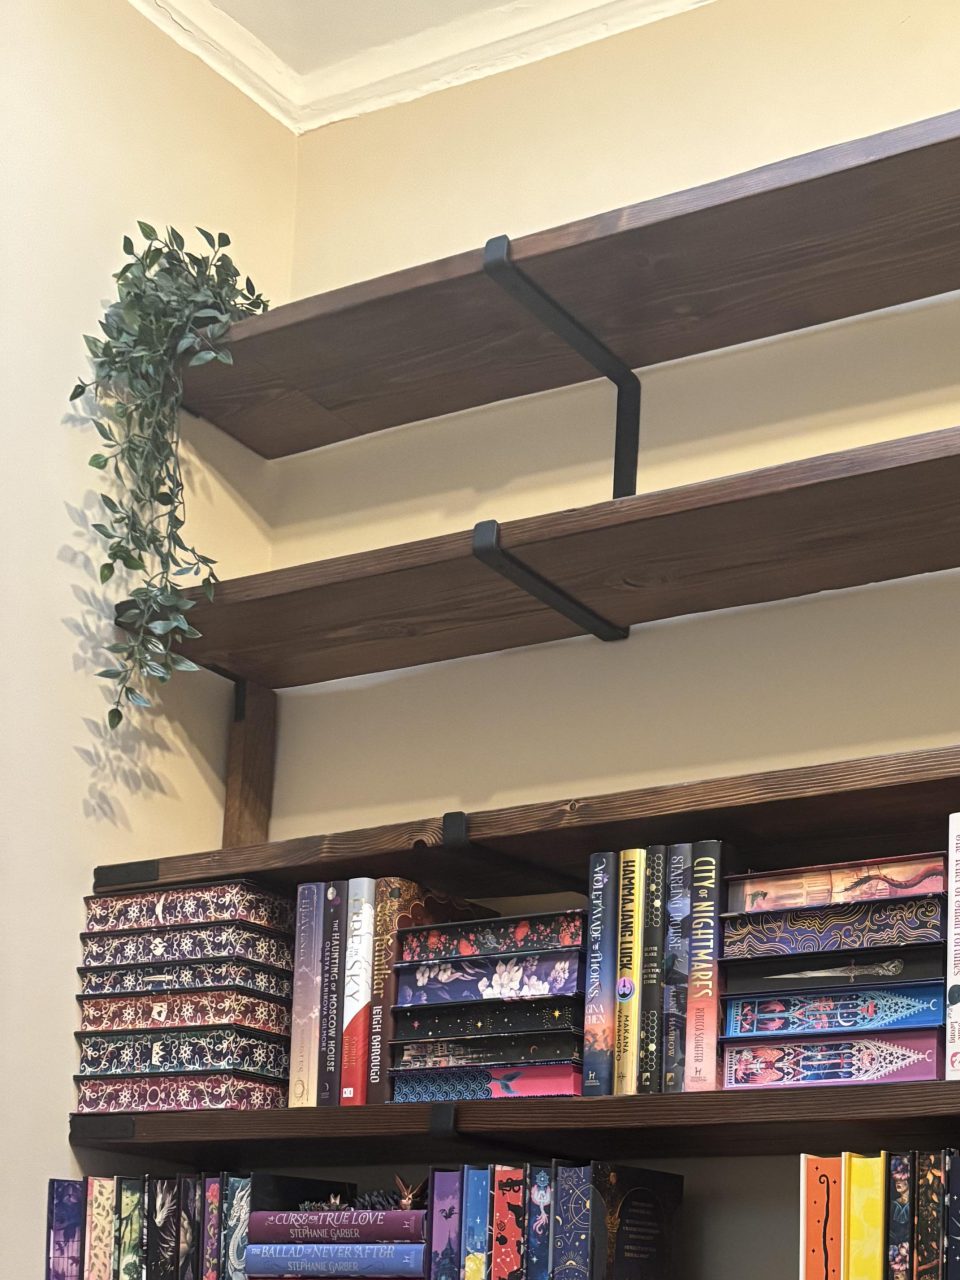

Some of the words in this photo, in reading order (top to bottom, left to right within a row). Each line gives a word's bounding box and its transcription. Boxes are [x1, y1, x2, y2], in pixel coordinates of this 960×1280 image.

[670, 855, 683, 907] STARLING
[693, 857, 715, 888] CITY
[620, 860, 635, 938] HAMMAJANG
[669, 914, 682, 950] HOUSE
[330, 933, 339, 980] HAUNTING
[620, 941, 633, 971] LUCK
[691, 902, 715, 999] NIGHTMARES
[328, 994, 337, 1037] MOSCOW
[372, 1006, 383, 1032] LEIGH
[327, 1041, 336, 1072] HOUSE
[290, 1227, 329, 1238] STEPHANIE
[330, 1229, 359, 1240] GARBER
[352, 1212, 385, 1225] LOVE
[261, 1245, 305, 1257] BALLAD
[311, 1245, 354, 1258] NEVER
[287, 1260, 328, 1271] STEPHANIE
[330, 1262, 359, 1273] GARBER
